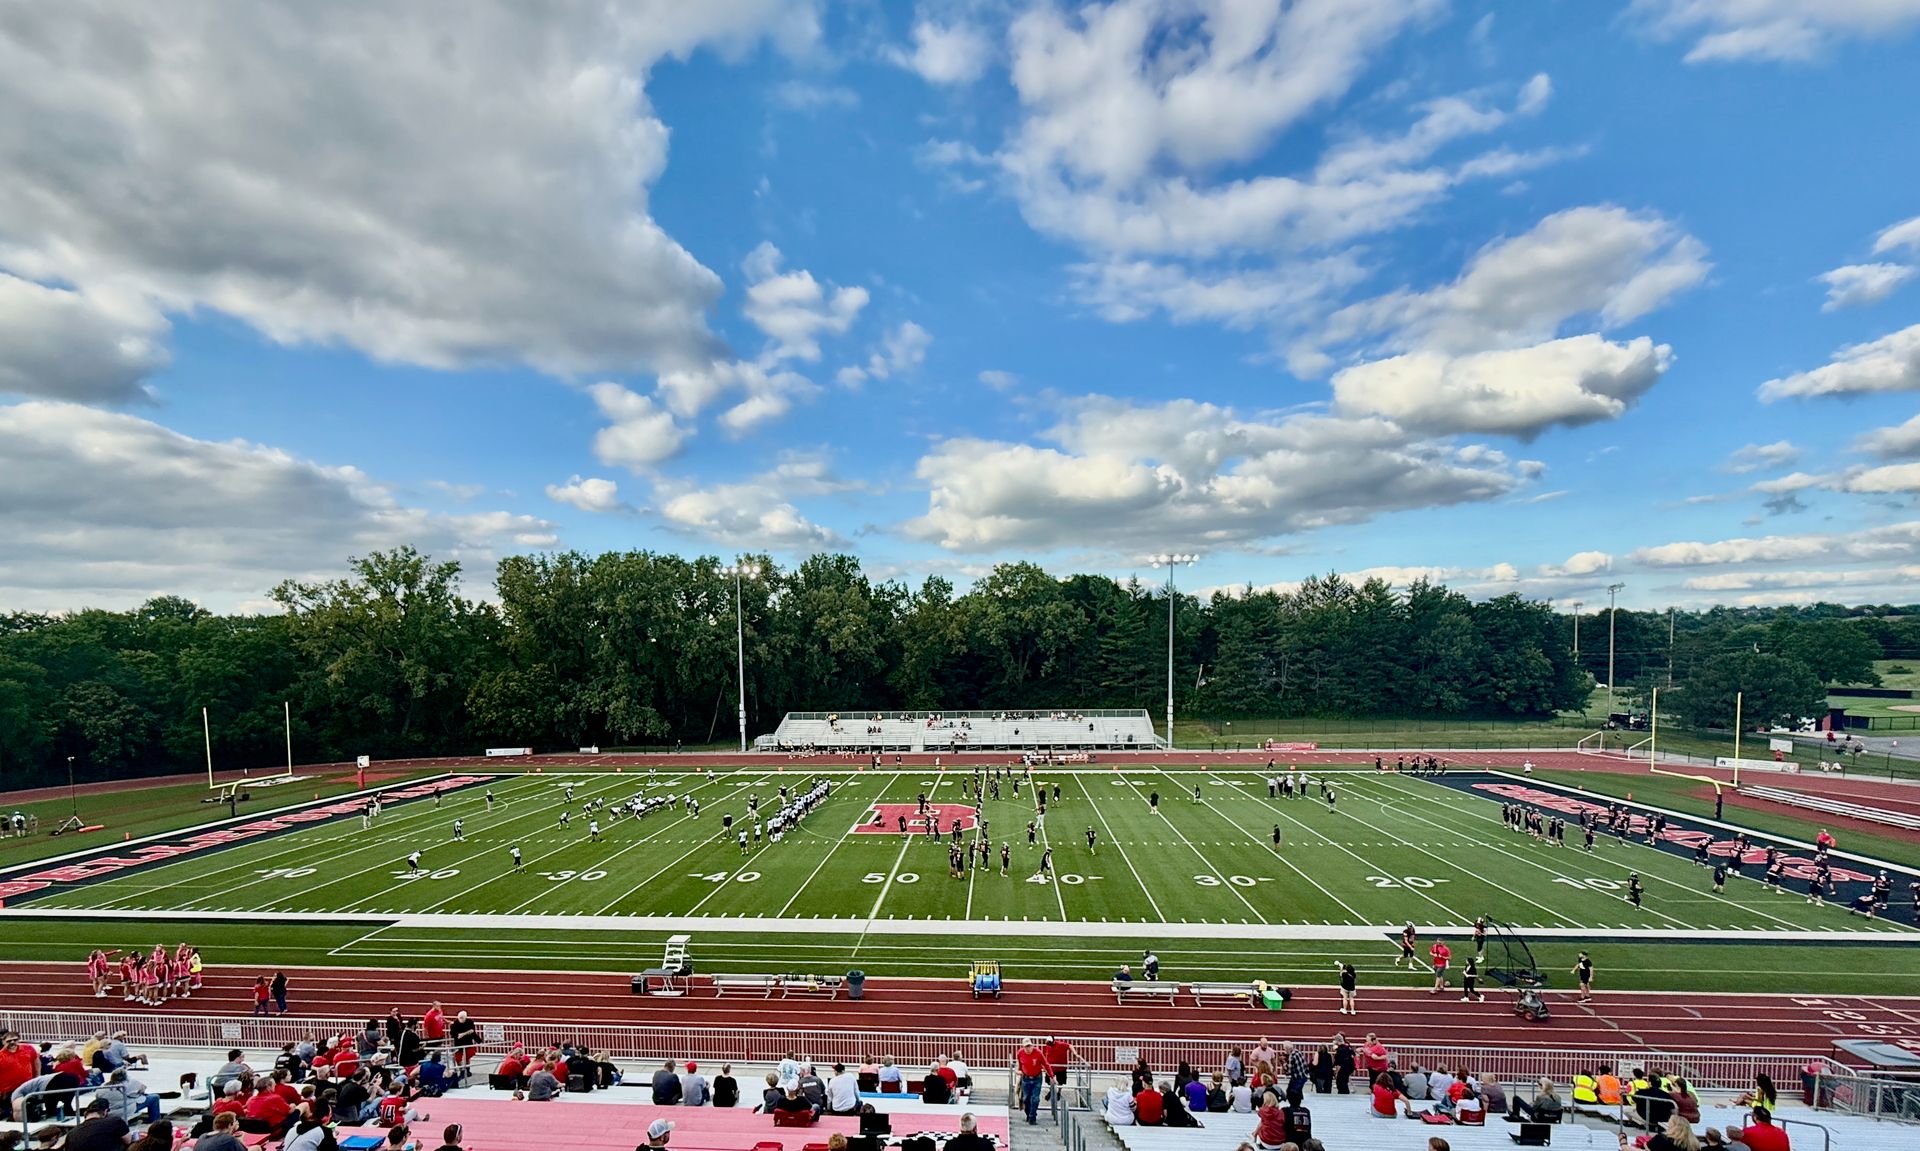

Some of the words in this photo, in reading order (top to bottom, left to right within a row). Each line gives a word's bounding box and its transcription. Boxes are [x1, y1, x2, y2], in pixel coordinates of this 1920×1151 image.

[846, 803, 978, 835] B
[547, 870, 608, 881] 30
[702, 871, 762, 882] 40
[861, 872, 920, 884] 50
[1025, 873, 1085, 885] 40
[1193, 875, 1257, 887] 30
[1365, 876, 1435, 888] 20
[1551, 878, 1621, 890] 10
[1822, 1011, 1867, 1020] 2
[1857, 1024, 1902, 1035] 3
[379, 1104, 396, 1123] 14
